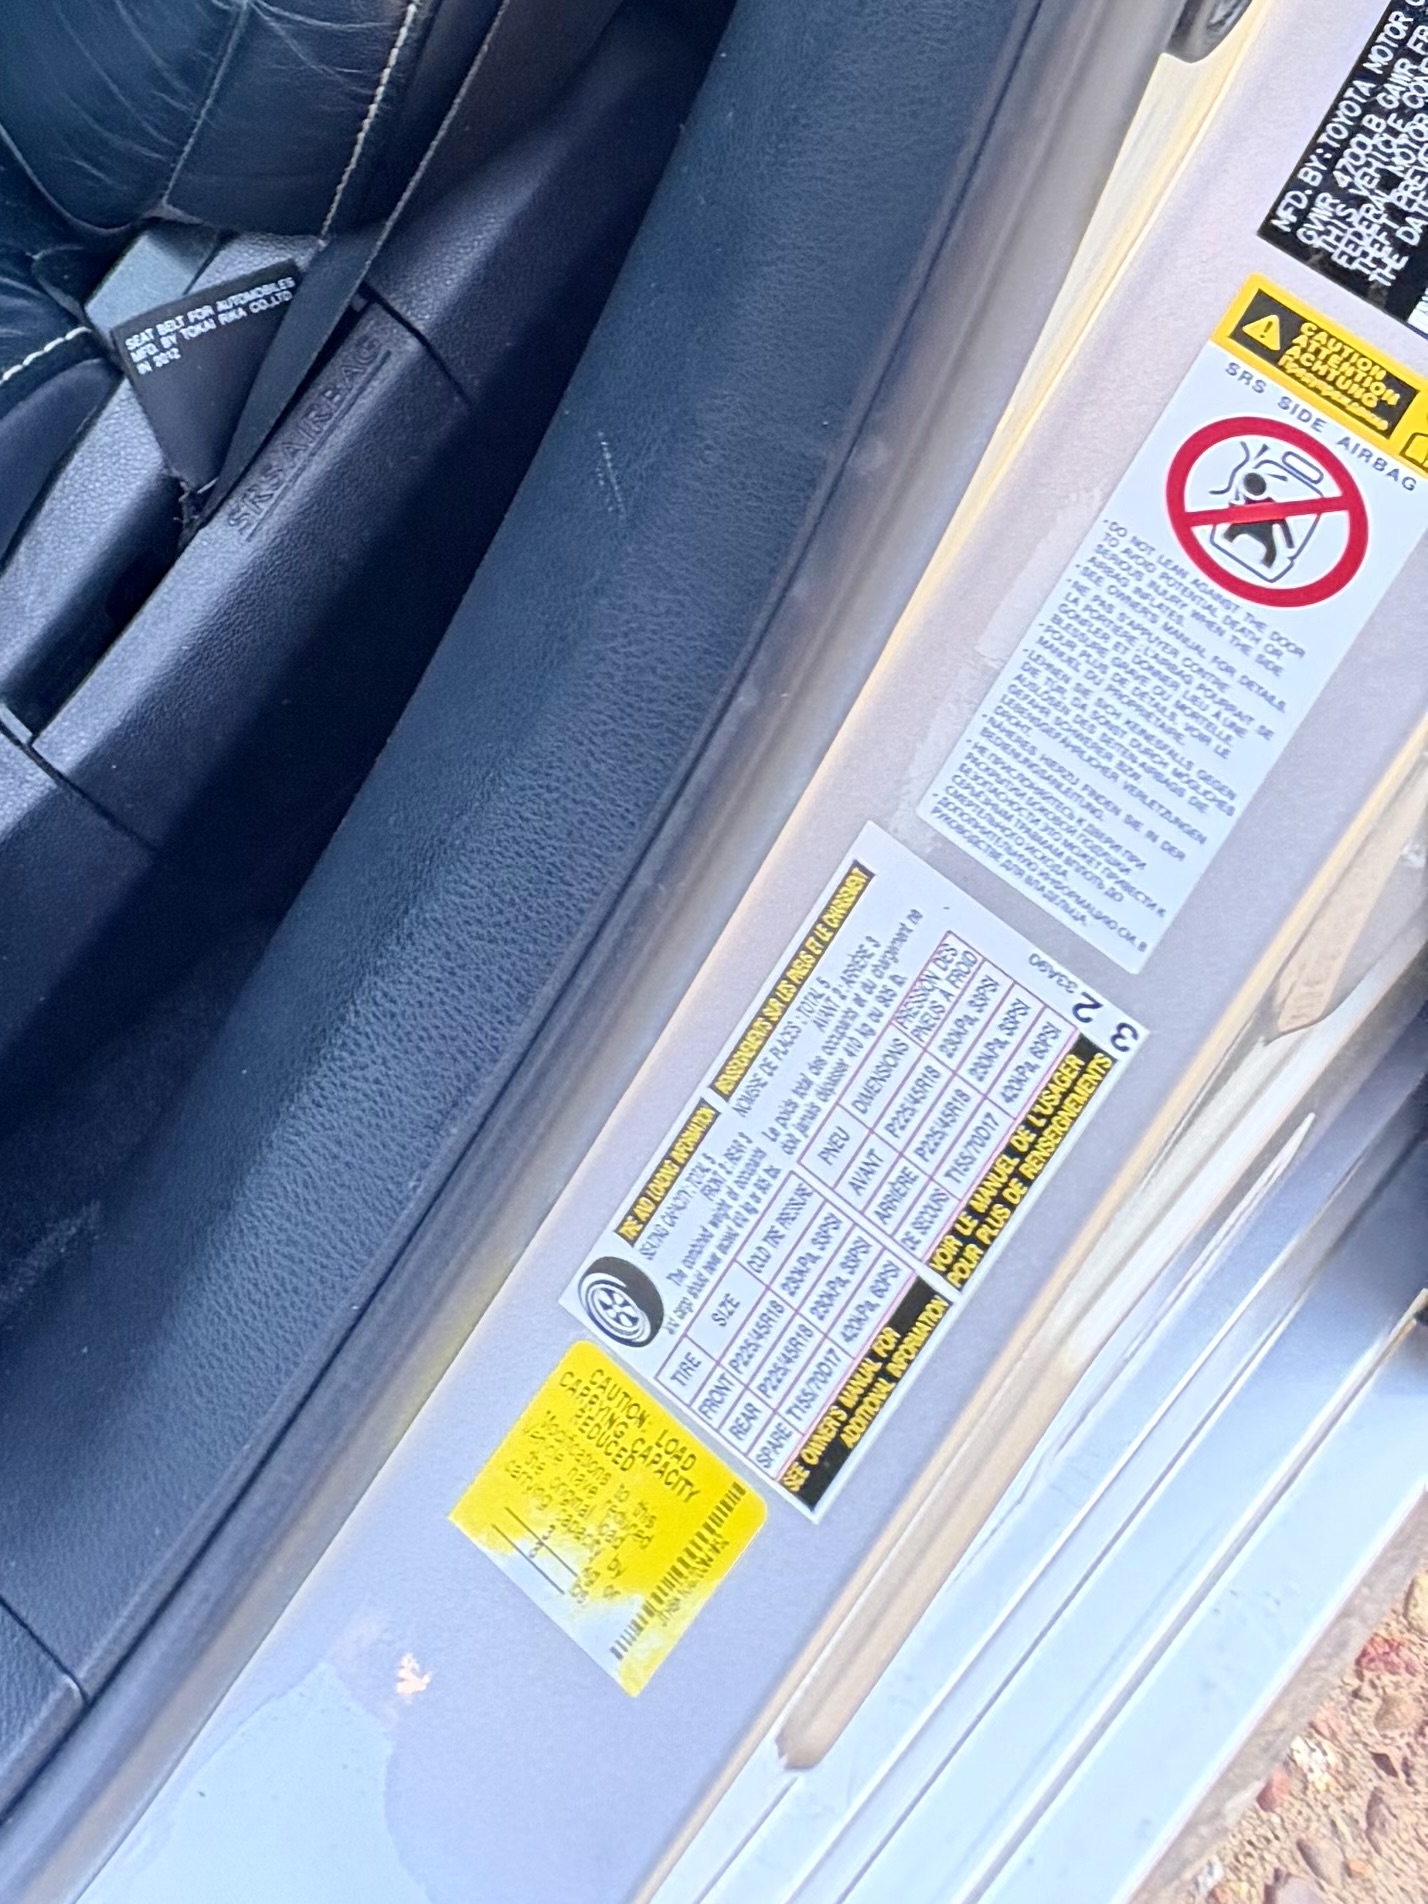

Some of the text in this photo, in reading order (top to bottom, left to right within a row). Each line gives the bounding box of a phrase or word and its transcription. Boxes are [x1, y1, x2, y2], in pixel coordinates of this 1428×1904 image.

[1361, 7, 1414, 76] MOTOR
[1294, 189, 1341, 248] GVWR
[1374, 55, 1420, 112] GAWR
[1313, 200, 1358, 256] THIS
[1346, 111, 1412, 202] VEHICLE
[1330, 183, 1394, 270] FEDERAL
[1351, 212, 1402, 278] THEFT
[1368, 244, 1408, 290] THE
[123, 274, 296, 351] SEAT BELT FOR AUTOMOBILES
[159, 331, 180, 350] BY
[178, 317, 217, 341] TOKAI
[217, 305, 247, 325] RIKA
[1298, 319, 1387, 382] CAUTION
[135, 359, 152, 375] IN
[1284, 341, 1380, 410] ACHTUNG
[1291, 329, 1401, 407] ATTENTION
[1223, 359, 1269, 395] SRS
[1275, 393, 1328, 434] SIDE
[1335, 432, 1419, 493] AIRBAG
[803, 935, 826, 957] ET
[812, 922, 834, 943] LE
[932, 941, 959, 972] DES
[758, 1055, 779, 1077] DE
[815, 974, 832, 990] 5
[760, 995, 786, 1023] SUR
[773, 977, 798, 1003] LES
[910, 998, 947, 1044] PNEUS
[945, 948, 980, 990] FROID
[1068, 990, 1103, 1027] 2
[1106, 1018, 1141, 1055] 3
[761, 1122, 781, 1143] Le
[817, 1035, 910, 1166] PNEU DIMENSIONS
[847, 1148, 885, 1195] AVANT
[884, 1063, 942, 1140] P225/45R18
[913, 1086, 972, 1164] P225/45R18
[618, 1101, 717, 1242] TIRE AND LOADING INFORMATION
[928, 1052, 1085, 1275] VOIR LE MANUEL DE L'USAGER
[945, 1110, 1003, 1185] T155/70D17
[945, 1049, 1114, 1289] POUR PLUS DE RENSEIGNEMENTS
[670, 1350, 702, 1390] TIRE
[710, 1291, 741, 1329] SIZE
[698, 1372, 736, 1421] FRONT
[728, 1298, 786, 1375] P225/45R18
[838, 1293, 949, 1449] ADDITIONAL INFORMATION
[728, 1400, 761, 1442] REAR
[756, 1322, 815, 1400] P225/45R18
[754, 1421, 793, 1470] SPARE
[786, 1346, 844, 1423] T155/70D17
[782, 1324, 902, 1494] SEE OWNER'S MANUAL FOR
[557, 1368, 631, 1442] CARRYING
[627, 1434, 701, 1507] CAPACITY
[569, 1405, 637, 1474] REDUCED
[653, 1427, 698, 1475] LOAD
